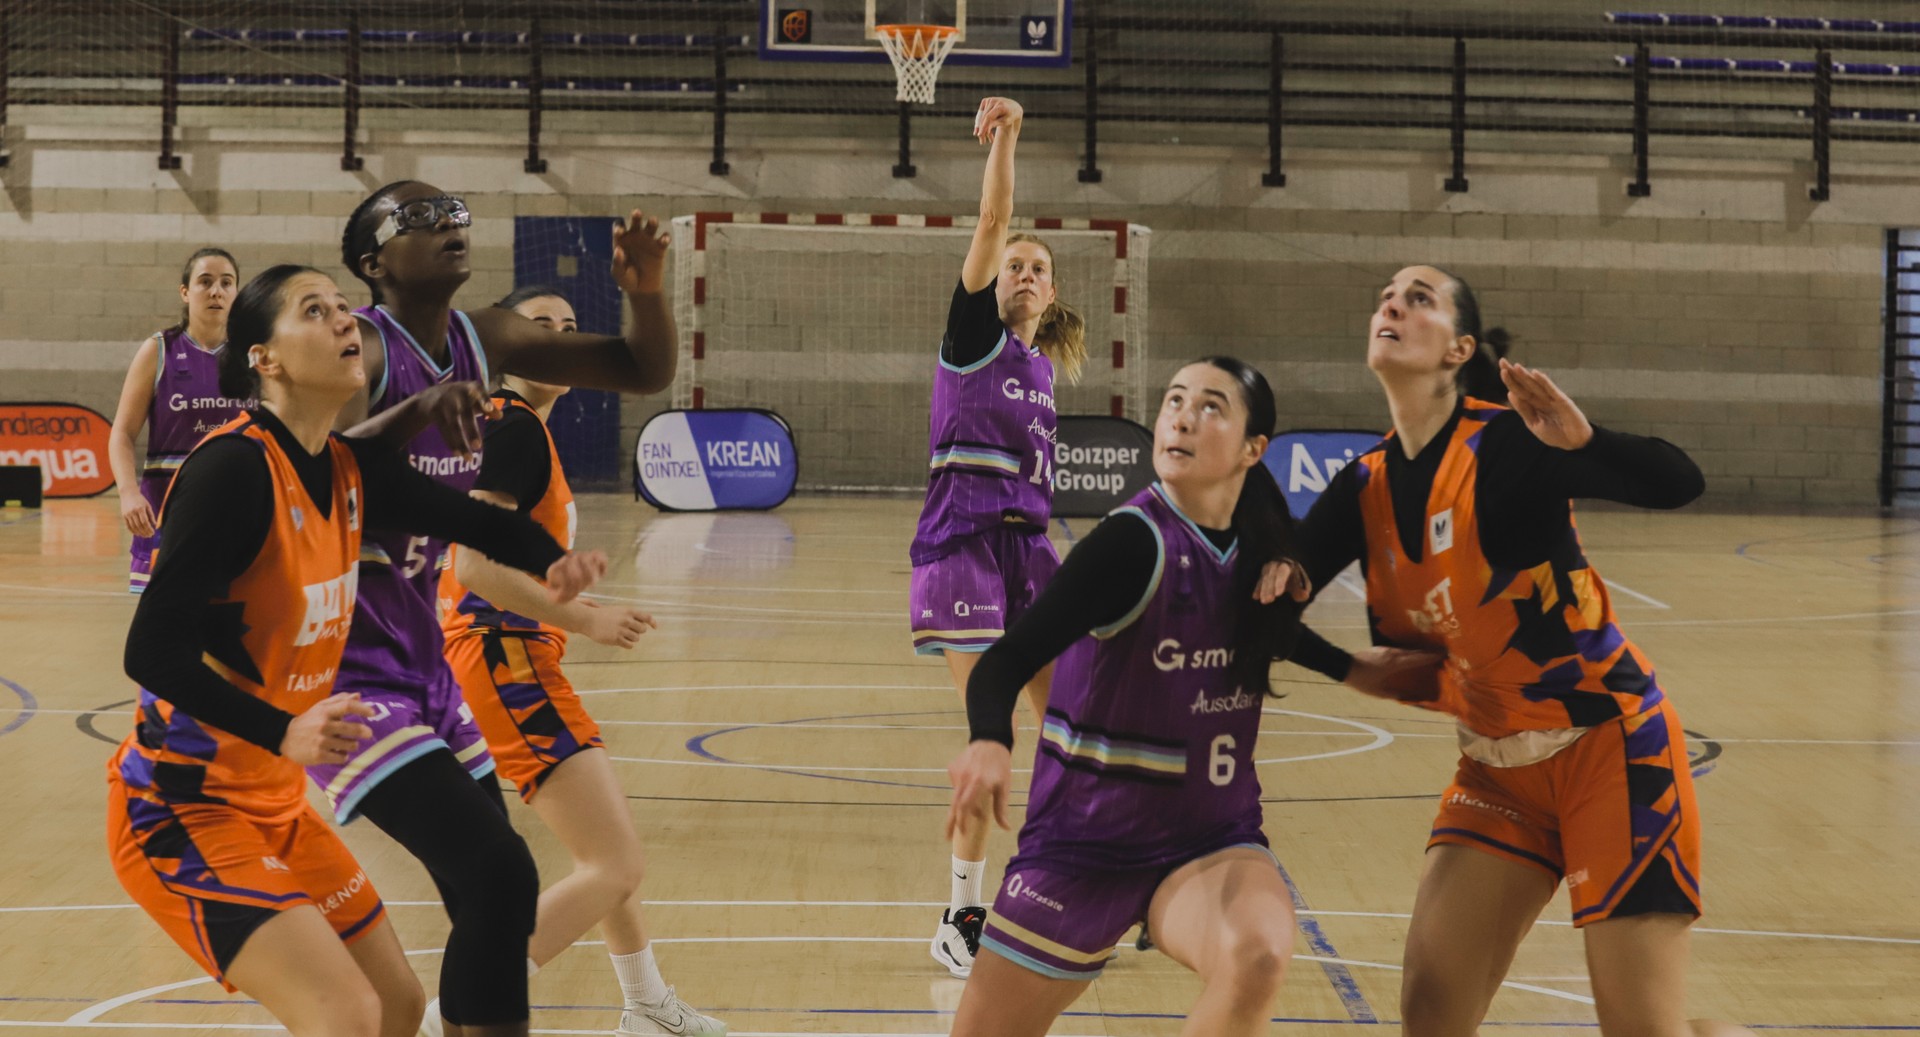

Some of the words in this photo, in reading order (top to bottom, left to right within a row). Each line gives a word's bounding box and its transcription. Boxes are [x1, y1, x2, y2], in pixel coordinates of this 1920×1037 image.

[643, 443, 671, 459] FAN
[707, 441, 781, 467] KREAN
[1055, 443, 1139, 469] Goizper
[645, 461, 700, 479] OINTXE!
[1055, 469, 1125, 495] Group
[402, 535, 429, 579] 5
[1191, 647, 1235, 669] sm
[1208, 733, 1236, 786] 6
[1022, 886, 1064, 912] Arrasate
